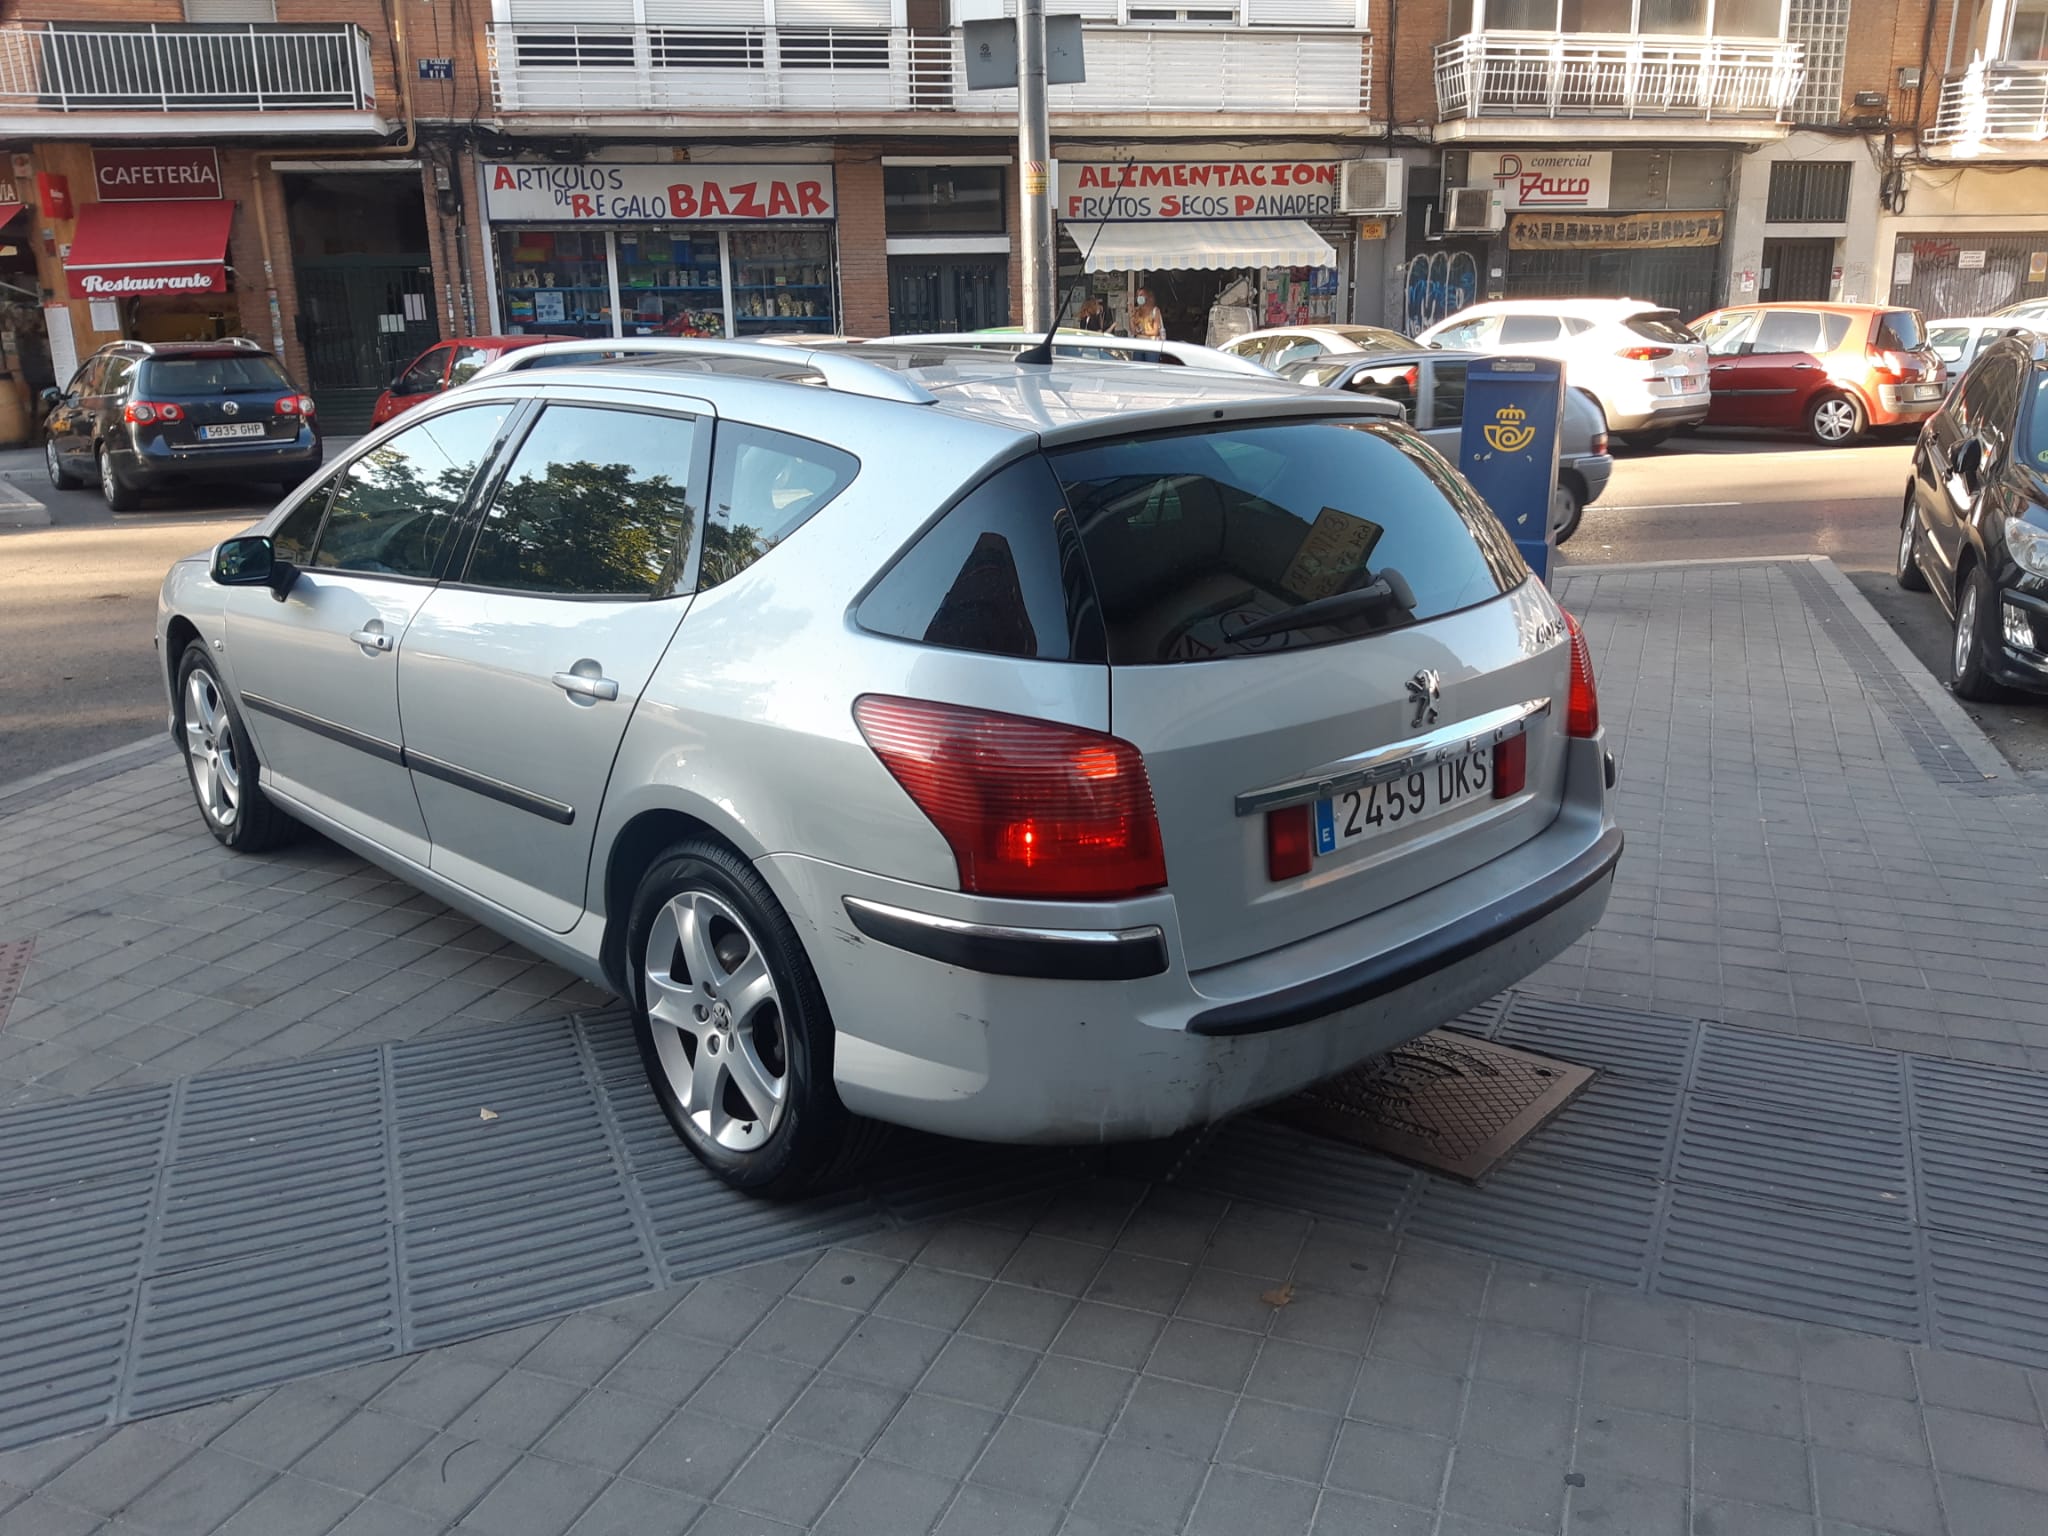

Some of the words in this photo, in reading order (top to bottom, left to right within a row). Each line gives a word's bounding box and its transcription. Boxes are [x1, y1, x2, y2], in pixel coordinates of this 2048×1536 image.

[1531, 154, 1592, 167] comercial
[100, 162, 215, 185] CAFETERÍA
[494, 165, 624, 192] ARTICULOS
[1078, 164, 1336, 188] ALIMENTACION
[555, 189, 571, 207] DE
[571, 193, 666, 219] REGALO
[667, 180, 830, 219] BAZAR
[1068, 195, 1151, 218] FRUTOS
[1158, 195, 1229, 218] SECOS
[1235, 194, 1335, 217] PANADERI
[81, 273, 213, 293] Restaurante
[240, 424, 262, 435] GHP
[1342, 771, 1425, 838] 2459
[1438, 750, 1488, 806] DKS
[1321, 827, 1331, 842] E
